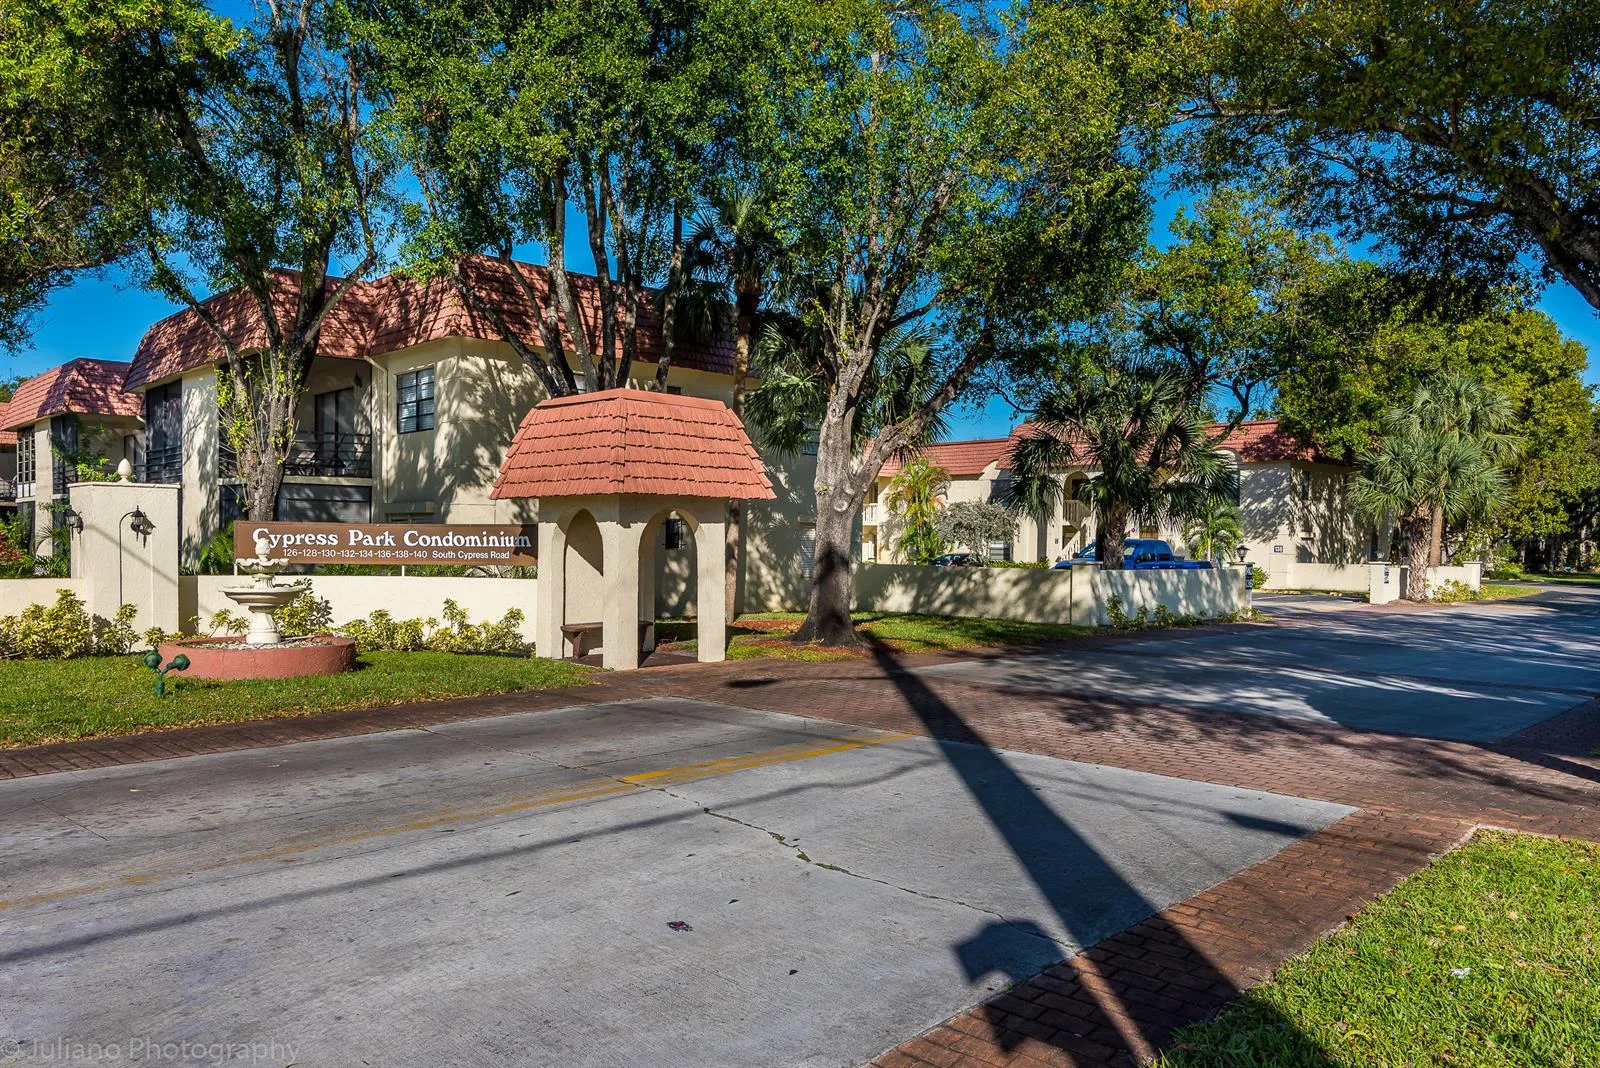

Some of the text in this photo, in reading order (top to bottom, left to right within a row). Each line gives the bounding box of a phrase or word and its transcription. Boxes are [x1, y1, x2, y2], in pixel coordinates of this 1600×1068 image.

[252, 527, 532, 548] Cypress Park Condominium
[283, 548, 510, 560] 126-128-130-132-134-136-138-140 South Cypress Road
